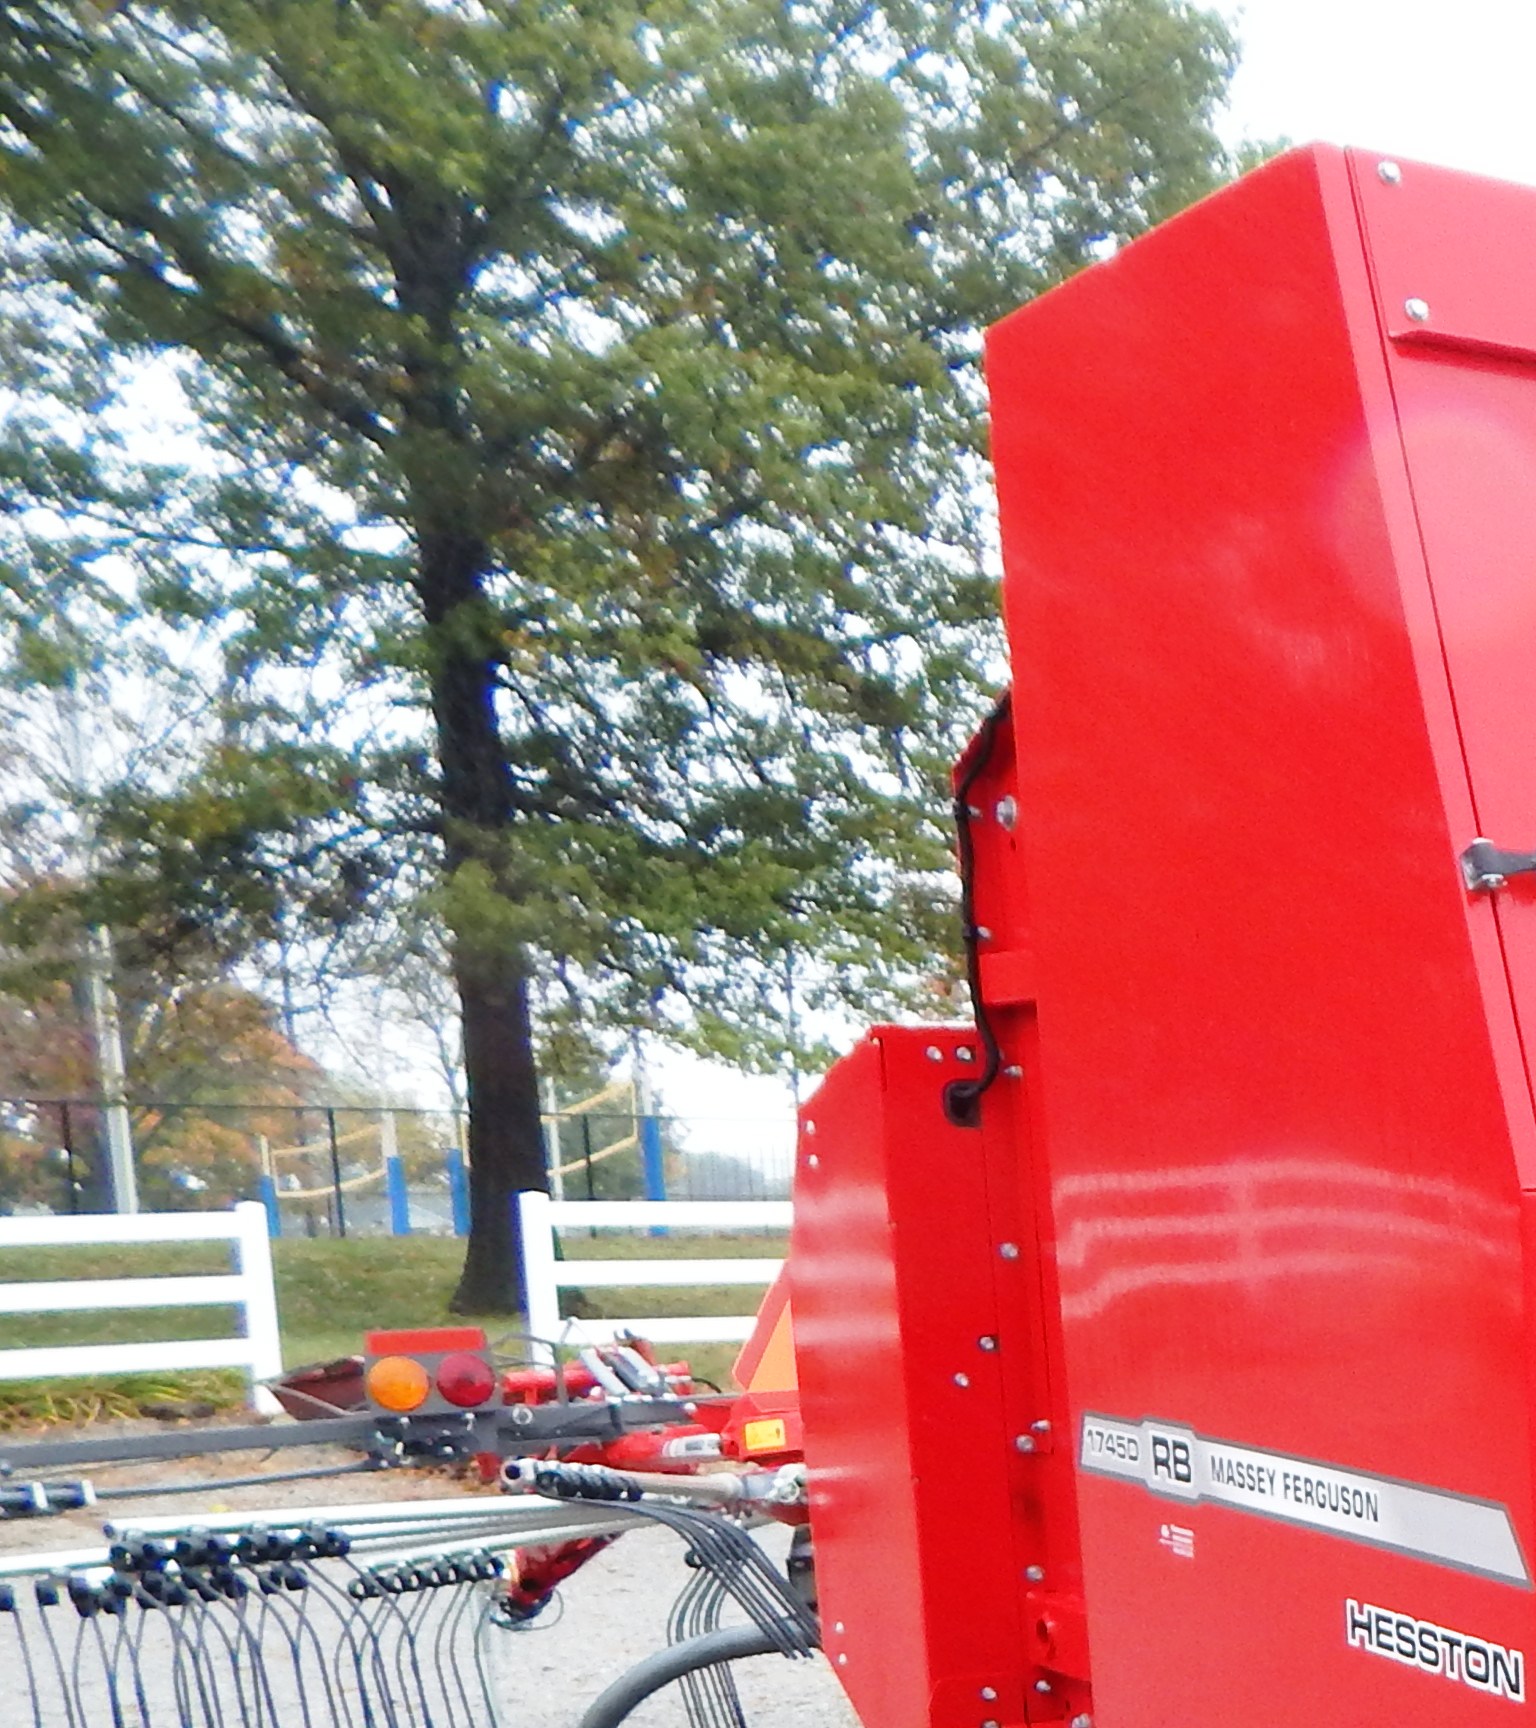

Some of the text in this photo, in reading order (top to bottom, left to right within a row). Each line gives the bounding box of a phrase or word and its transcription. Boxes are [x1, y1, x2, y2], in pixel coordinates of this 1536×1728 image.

[1151, 1434, 1192, 1483] RB
[1210, 1455, 1276, 1496] MASSEY
[1282, 1471, 1379, 1522] FERGUSON
[1347, 1600, 1523, 1699] HESSTON
